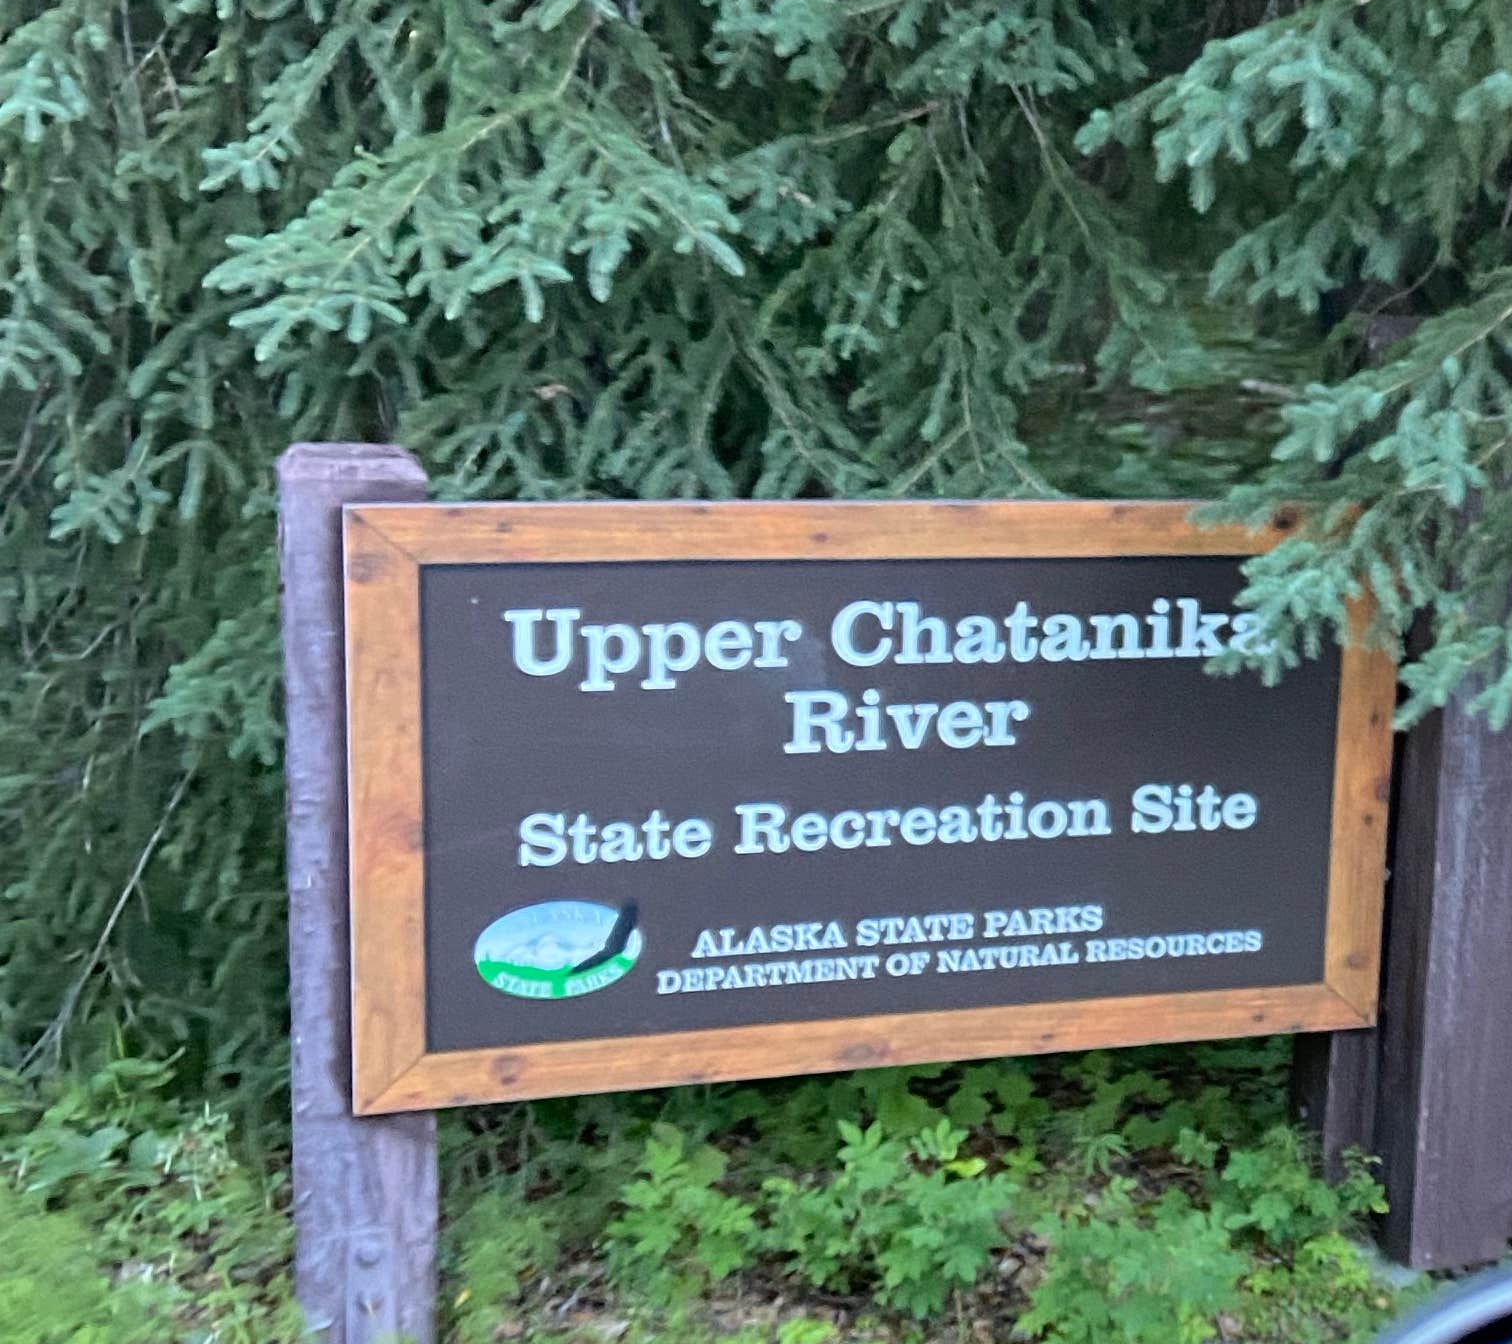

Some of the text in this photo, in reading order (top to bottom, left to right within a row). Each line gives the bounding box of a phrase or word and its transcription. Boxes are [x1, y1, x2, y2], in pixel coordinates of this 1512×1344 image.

[503, 607, 803, 692] Upper
[783, 689, 1032, 754] River
[518, 783, 1258, 867] State Recreation Site
[656, 929, 1263, 994] DEPARTMENT OF NATURAL RESOURCES
[690, 905, 1104, 958] ALASKA STATE PARKS
[496, 972, 553, 995] STATE
